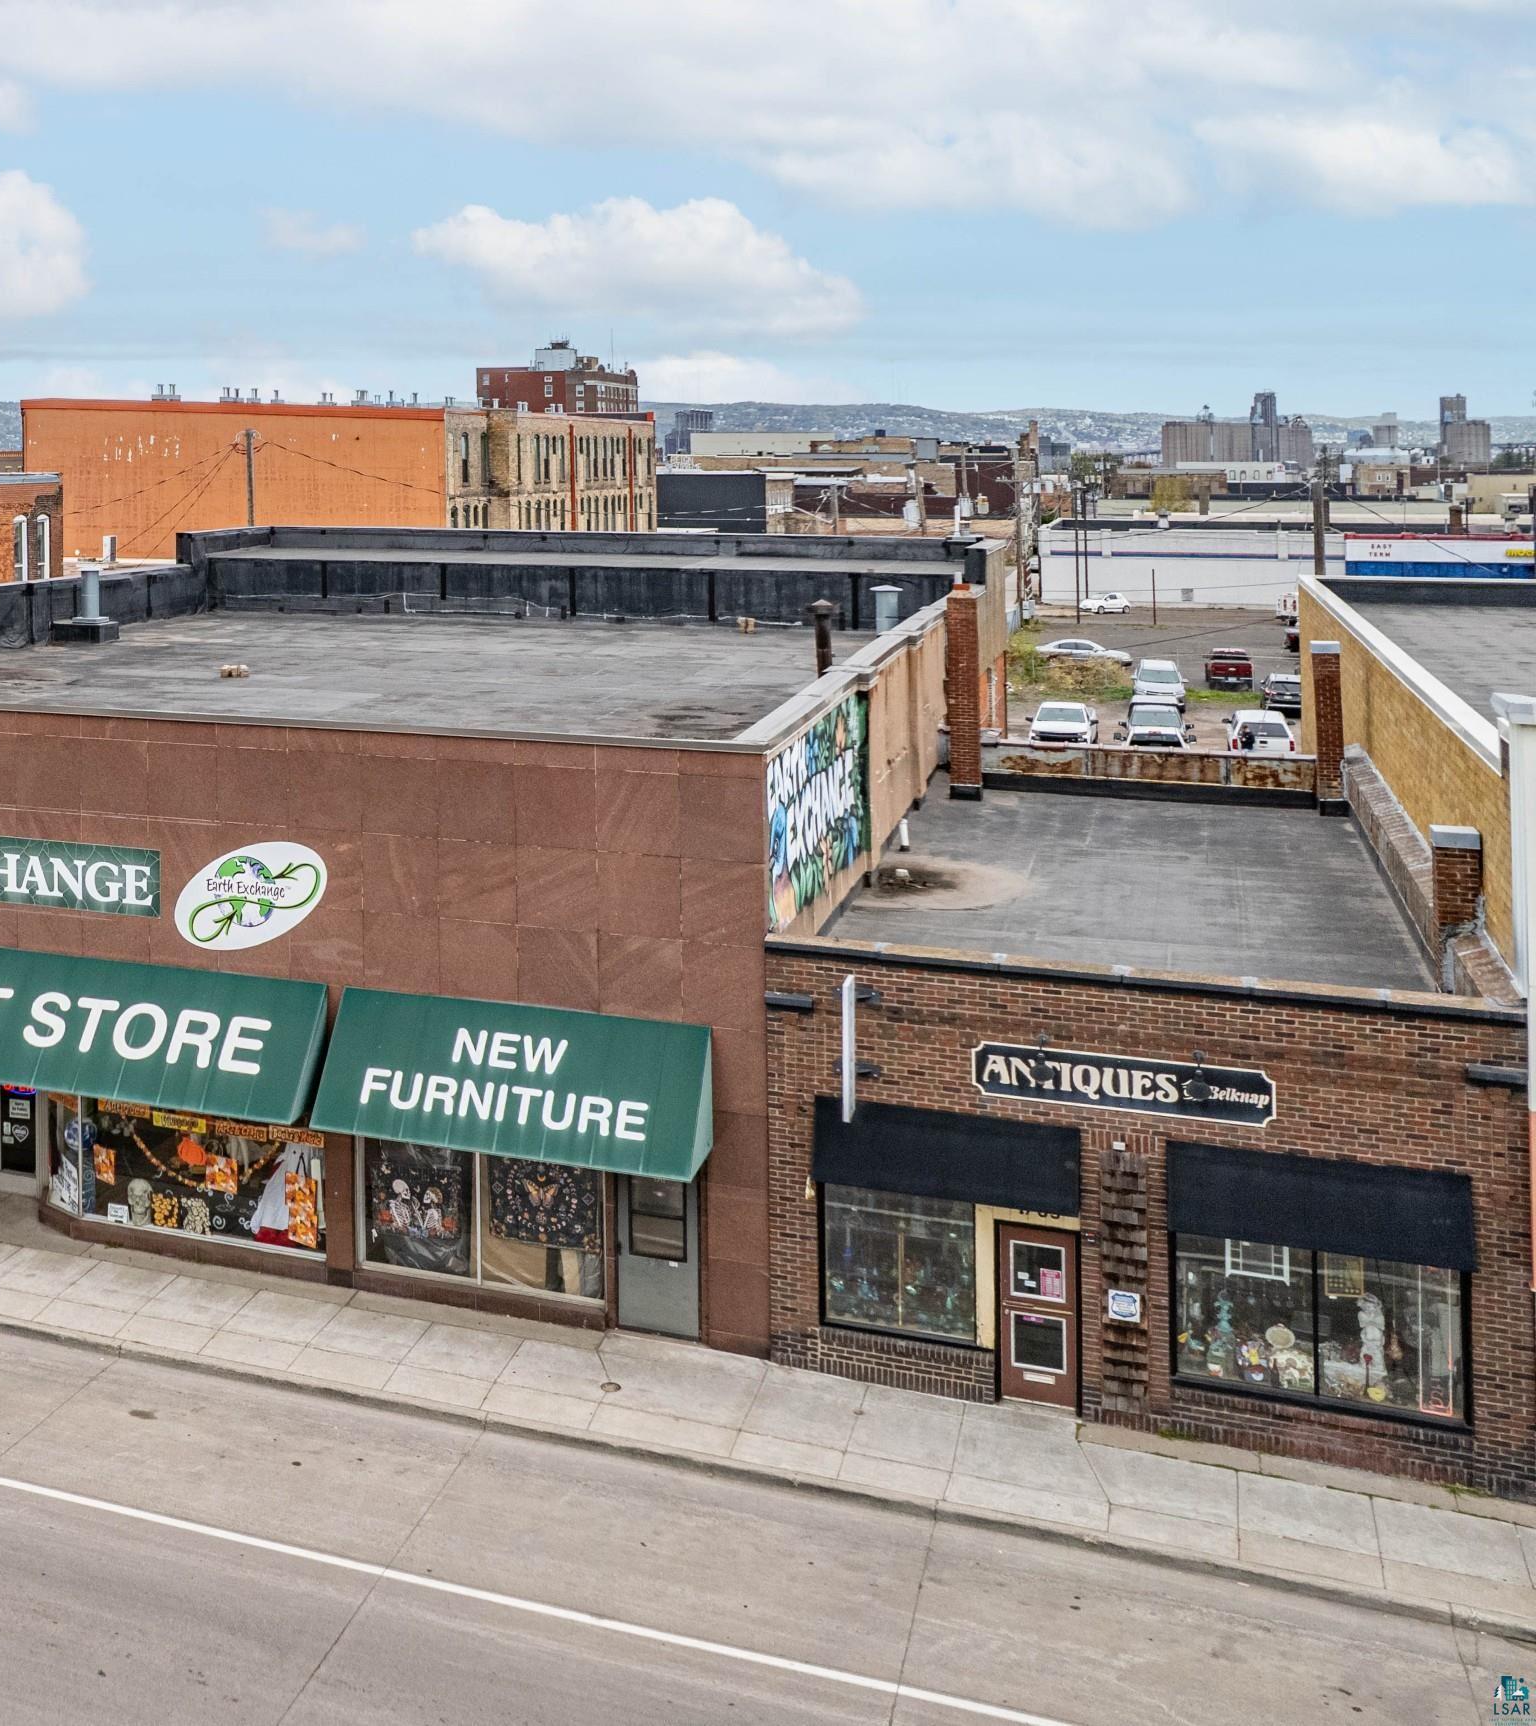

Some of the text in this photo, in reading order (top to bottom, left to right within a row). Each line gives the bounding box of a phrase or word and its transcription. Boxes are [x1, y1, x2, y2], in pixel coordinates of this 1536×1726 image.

[767, 735, 809, 824] EARTH
[785, 749, 856, 872] EXCHANGE
[206, 878, 286, 901] Earth Exchange
[22, 991, 273, 1076] STORE
[451, 1027, 569, 1076] NEW
[359, 1067, 650, 1142] FURNITURE
[982, 1054, 1179, 1103] ANTIQUES
[1208, 1085, 1271, 1109] Belknap
